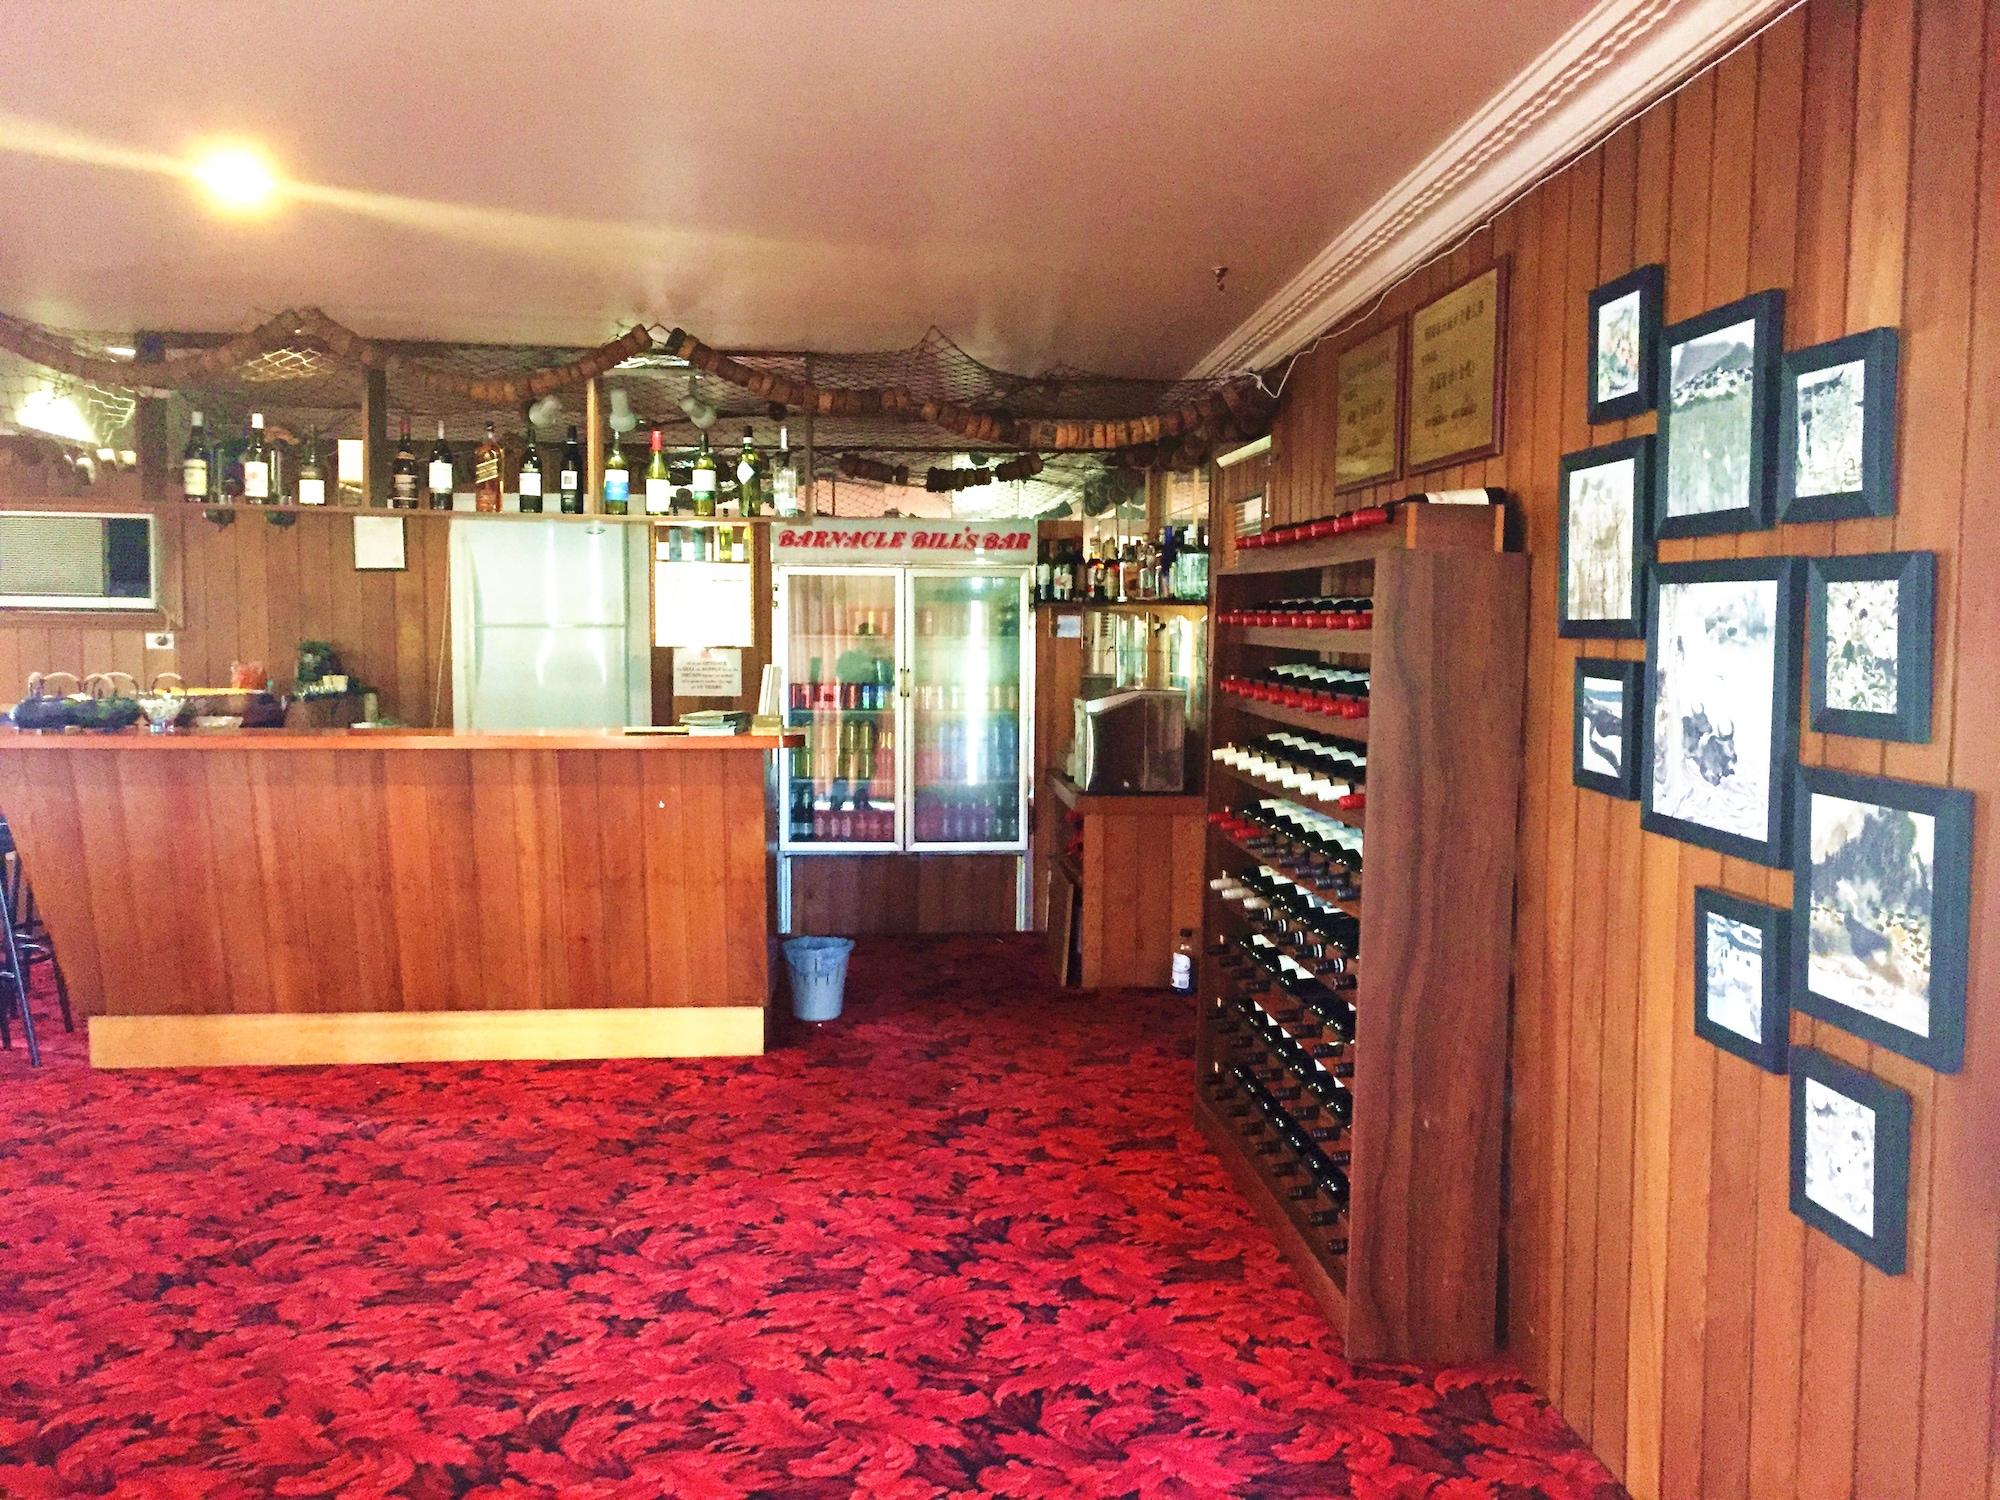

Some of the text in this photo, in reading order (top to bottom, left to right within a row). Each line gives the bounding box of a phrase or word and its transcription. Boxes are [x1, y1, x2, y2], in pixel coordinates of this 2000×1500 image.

[778, 526, 1032, 550] BARNACLE BILL'S BAR
